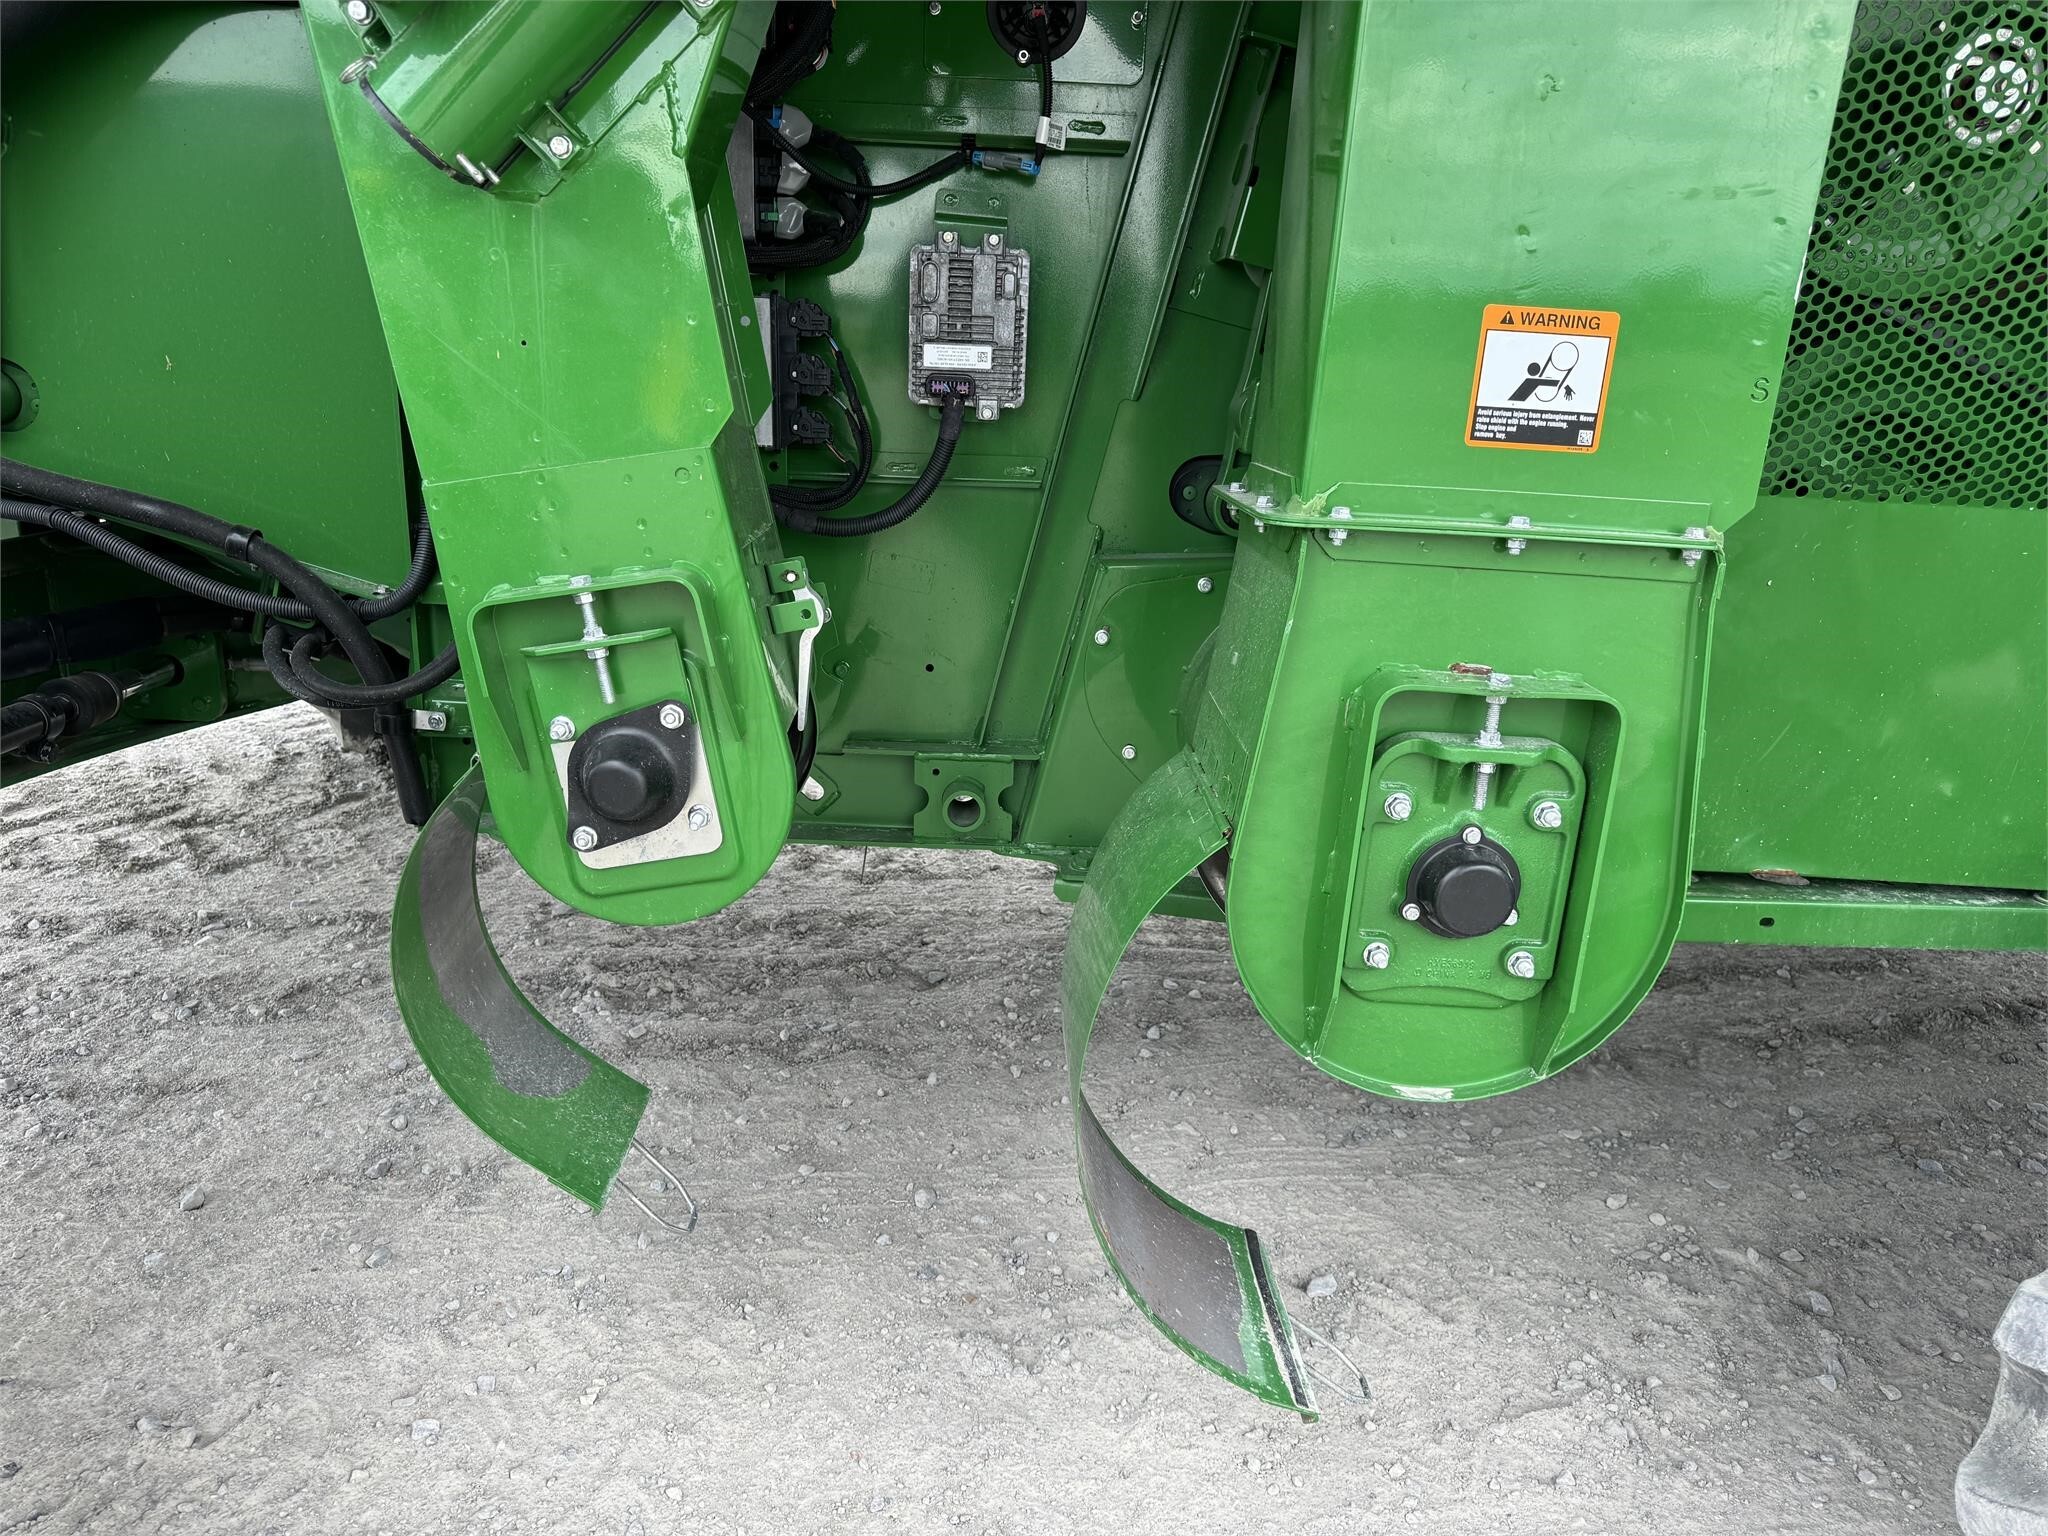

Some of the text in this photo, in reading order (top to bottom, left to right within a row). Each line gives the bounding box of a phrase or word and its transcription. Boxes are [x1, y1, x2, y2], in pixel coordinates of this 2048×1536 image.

[1520, 311, 1601, 330] WARNING
[1750, 377, 1770, 403] S
[1477, 408, 1493, 416] Avoid
[1493, 409, 1512, 417] serious
[1513, 410, 1528, 418] injury
[1542, 413, 1578, 422] entanglement.
[1580, 415, 1595, 423] Never
[1475, 423, 1488, 431] Stop
[1528, 419, 1547, 427] engine
[1547, 421, 1569, 429] running.
